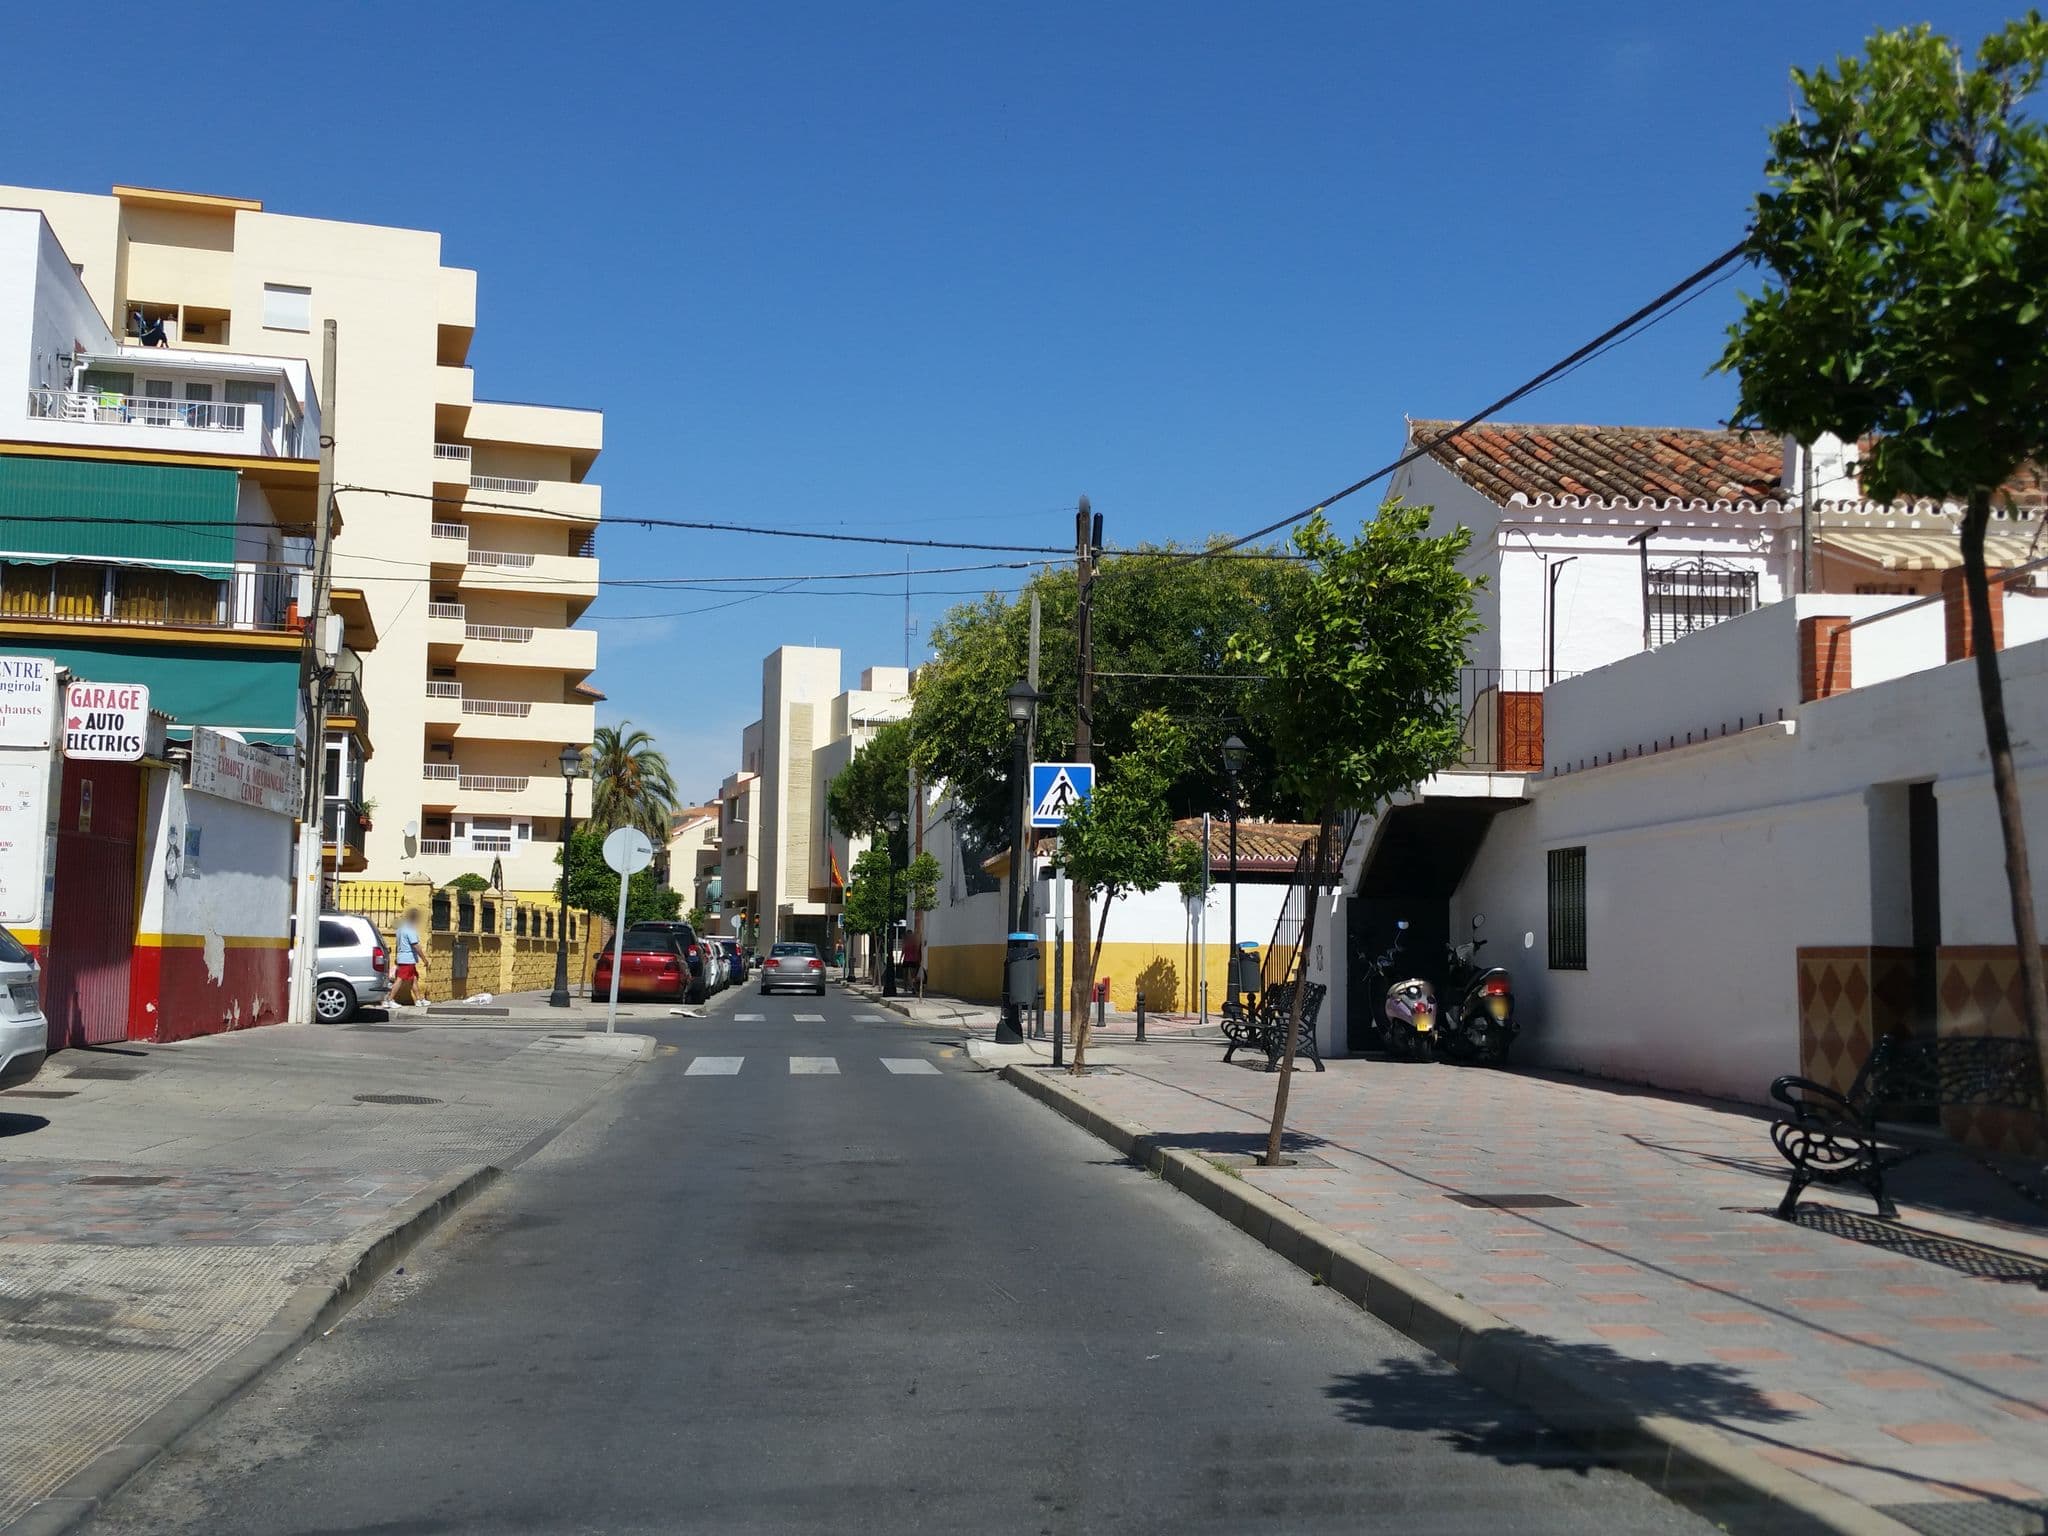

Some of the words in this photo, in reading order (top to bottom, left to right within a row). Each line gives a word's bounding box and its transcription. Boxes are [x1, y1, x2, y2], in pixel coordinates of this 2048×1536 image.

[0, 661, 43, 678] NTRE
[71, 688, 140, 710] GARAGE
[85, 713, 124, 731] AUTO
[67, 733, 140, 752] ELECTRICS
[218, 755, 244, 781] EXHAUST
[241, 782, 263, 806] CENTRE
